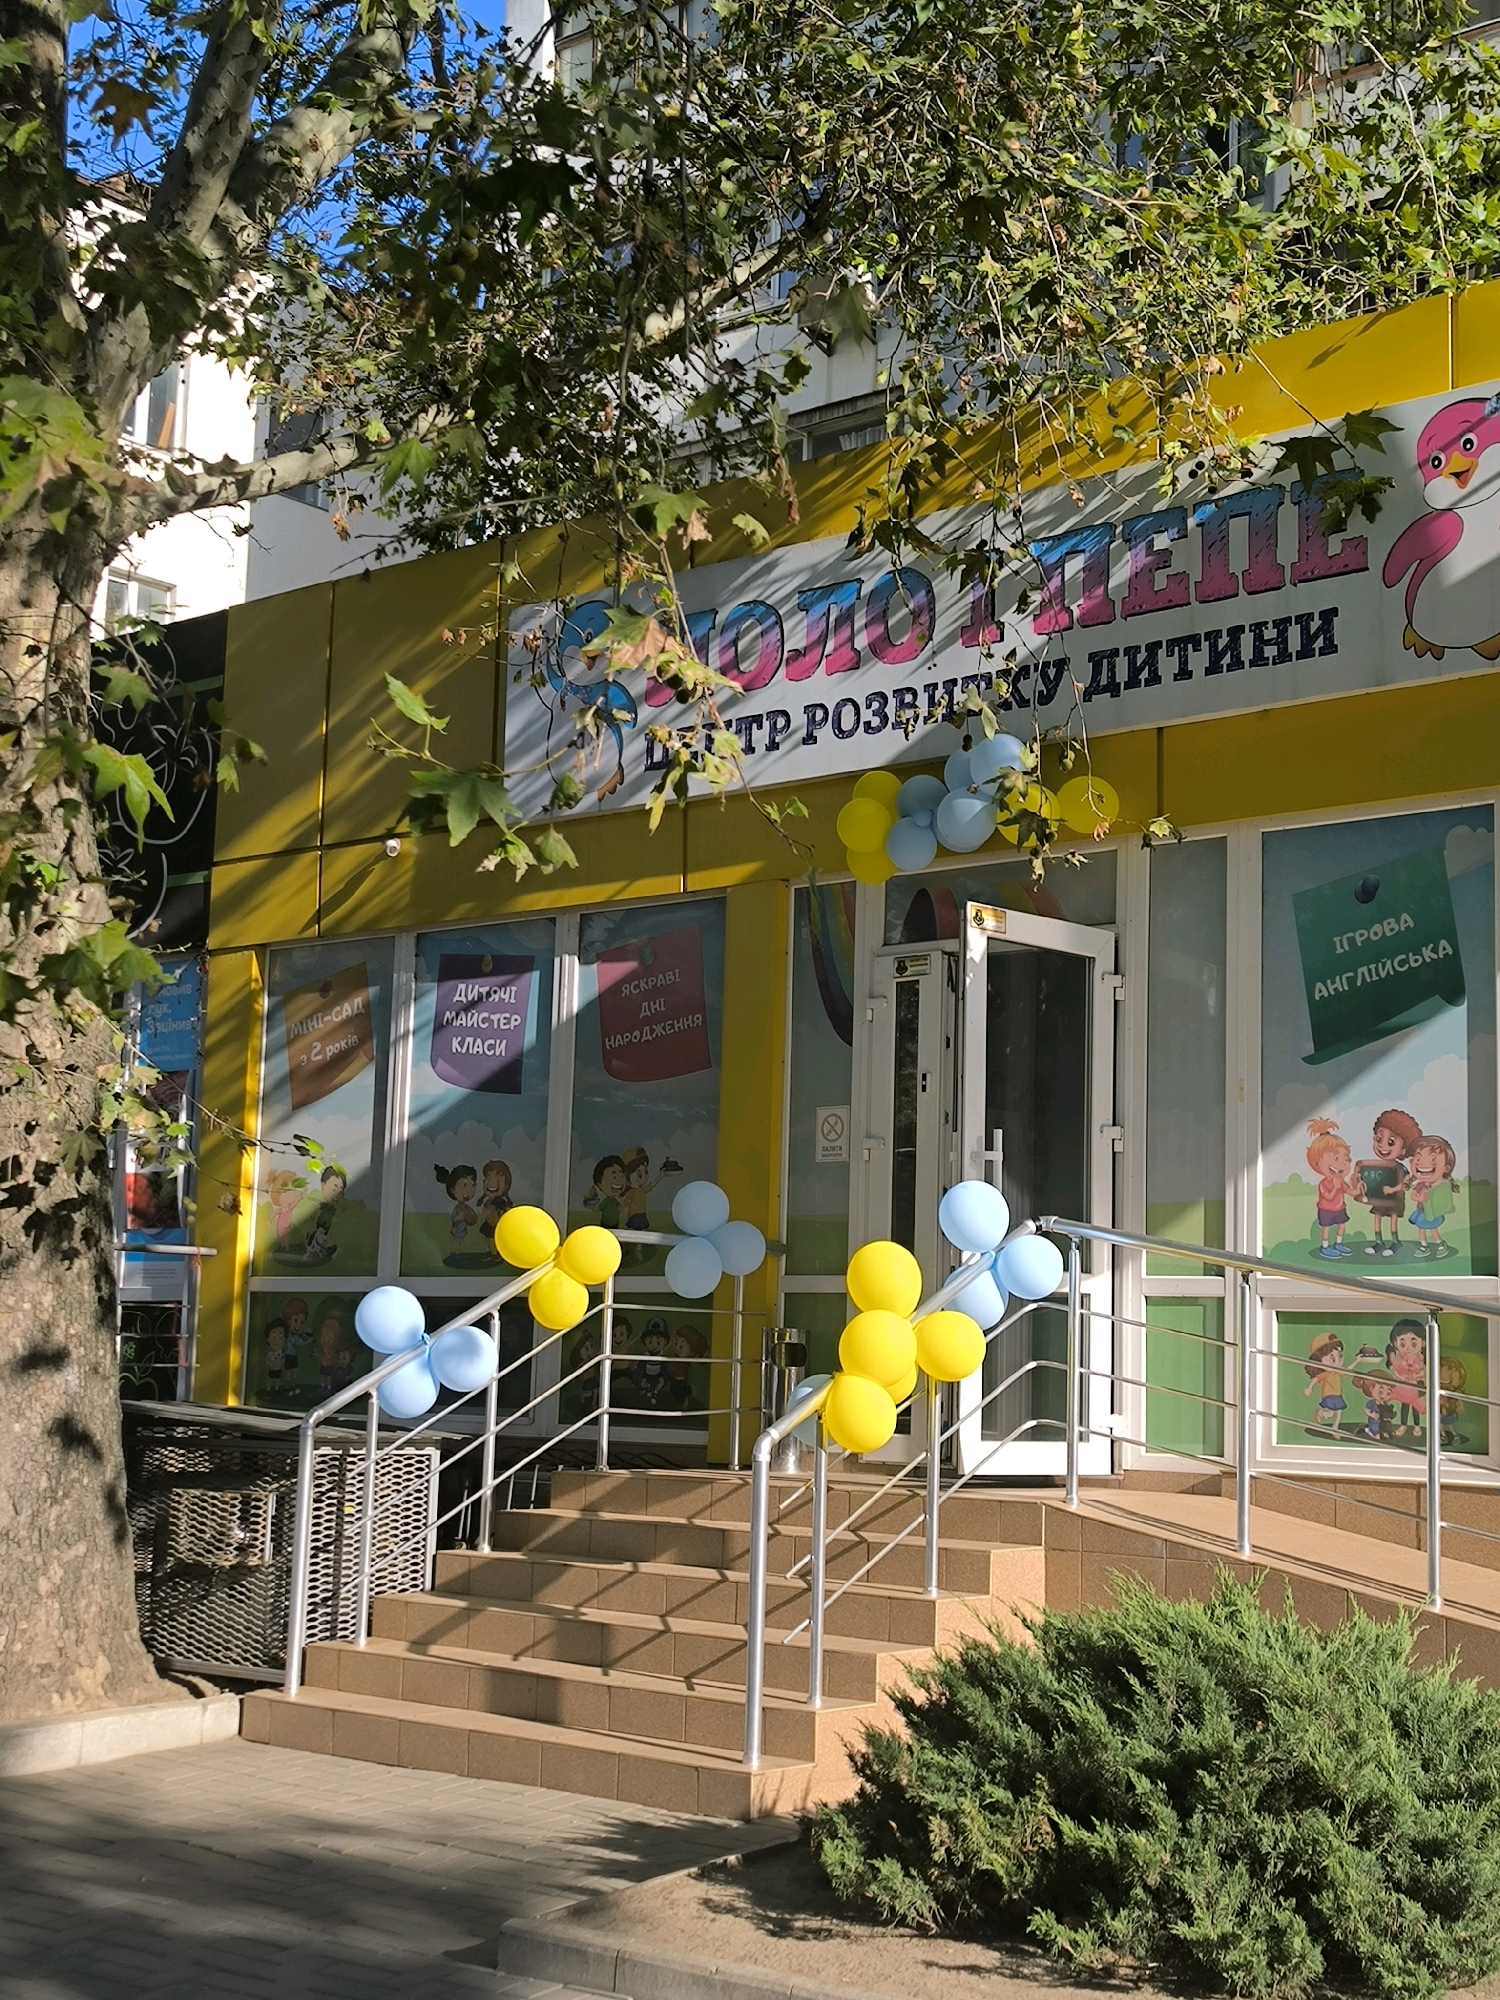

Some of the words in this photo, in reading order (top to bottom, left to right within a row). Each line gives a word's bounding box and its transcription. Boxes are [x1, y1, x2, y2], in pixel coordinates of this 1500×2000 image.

[1030, 468, 1370, 636] ПЕПЕ
[1082, 606, 1340, 703] ДИТИНИ
[1333, 912, 1415, 954] ІГРОВА
[621, 969, 681, 997] ЯСКРАВІ
[1314, 939, 1454, 1000] АНГЛІЙСЬКА
[453, 984, 517, 1004] ДИТЯЧІ
[640, 998, 666, 1019] ДНІ
[290, 996, 366, 1039] МІНІ-САД
[443, 1010, 522, 1031] МАЙСТЕР
[605, 1013, 703, 1050] НАРОДЖЕННЯ
[310, 1041, 323, 1062] 2
[325, 1034, 360, 1061] років
[451, 1036, 507, 1057] КЛАСИ
